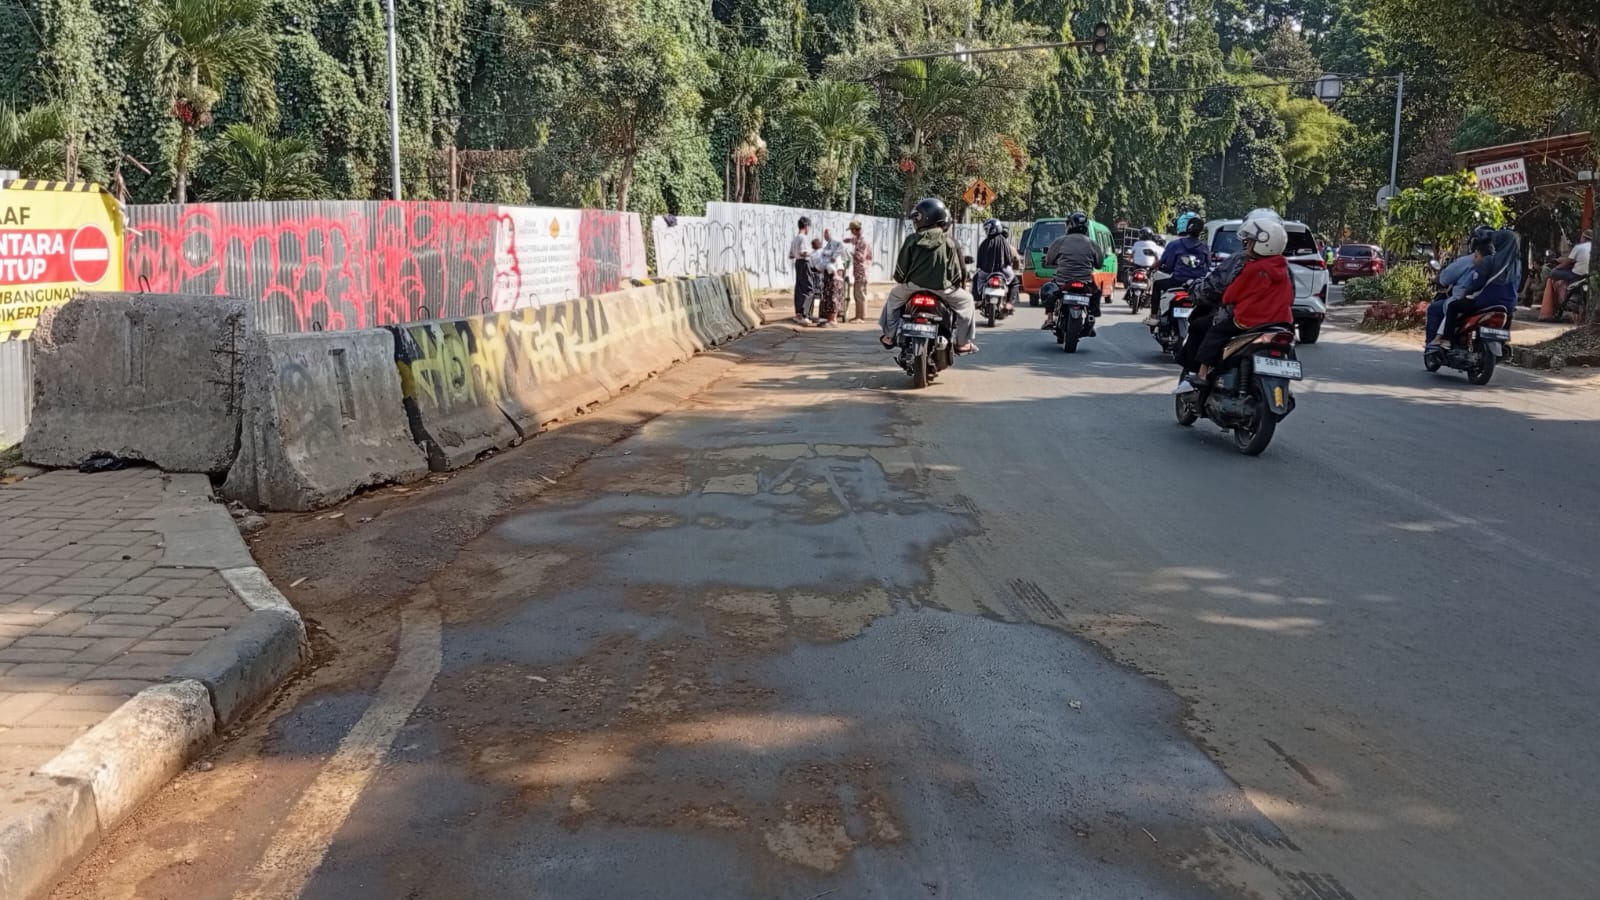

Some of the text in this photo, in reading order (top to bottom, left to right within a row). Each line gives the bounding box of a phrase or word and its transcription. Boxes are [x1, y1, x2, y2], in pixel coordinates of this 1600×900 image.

[1479, 171, 1525, 190] OKSIGEN
[0, 206, 31, 225] AF
[0, 258, 47, 282] TUP
[0, 287, 80, 305] BANGUNAN
